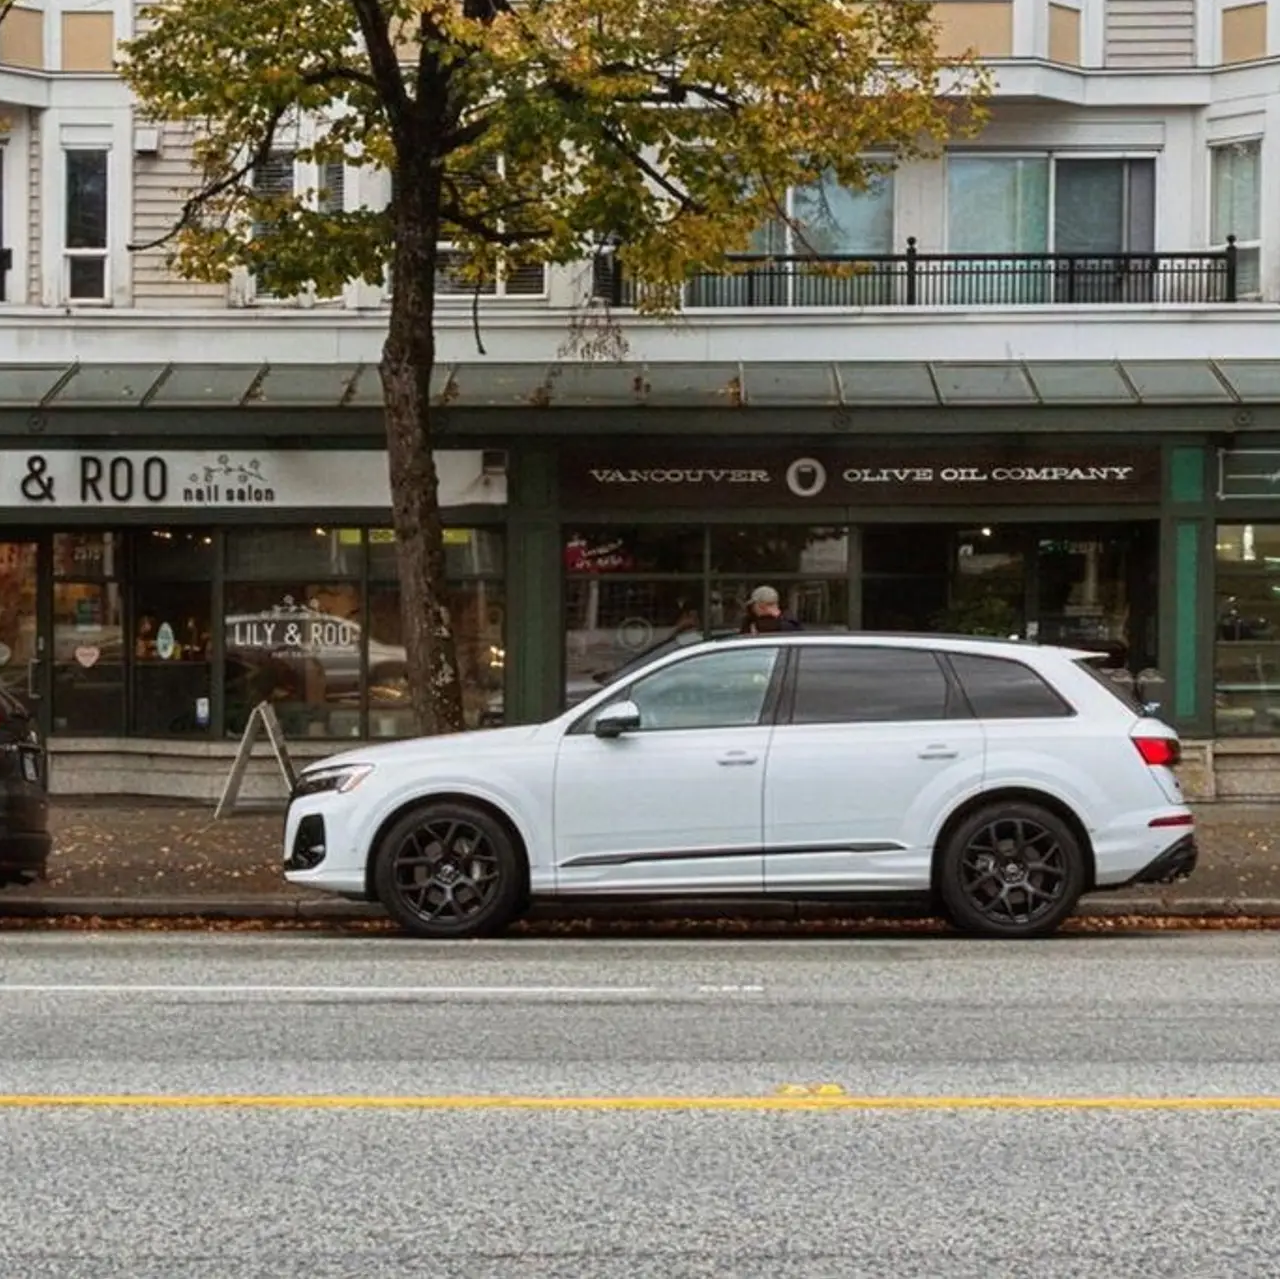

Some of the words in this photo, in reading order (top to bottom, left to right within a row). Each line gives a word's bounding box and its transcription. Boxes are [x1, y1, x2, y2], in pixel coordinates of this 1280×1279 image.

[21, 454, 54, 502] &
[80, 455, 167, 502] ROO
[590, 469, 770, 483] VANCOUVER
[842, 468, 934, 482] OLIVE
[939, 468, 988, 481] OIL
[991, 467, 1134, 481] COMPANY
[183, 485, 218, 503] nail
[225, 485, 275, 503] salon
[234, 623, 275, 646] LILY
[284, 622, 302, 646] &
[310, 622, 351, 646] ROO
